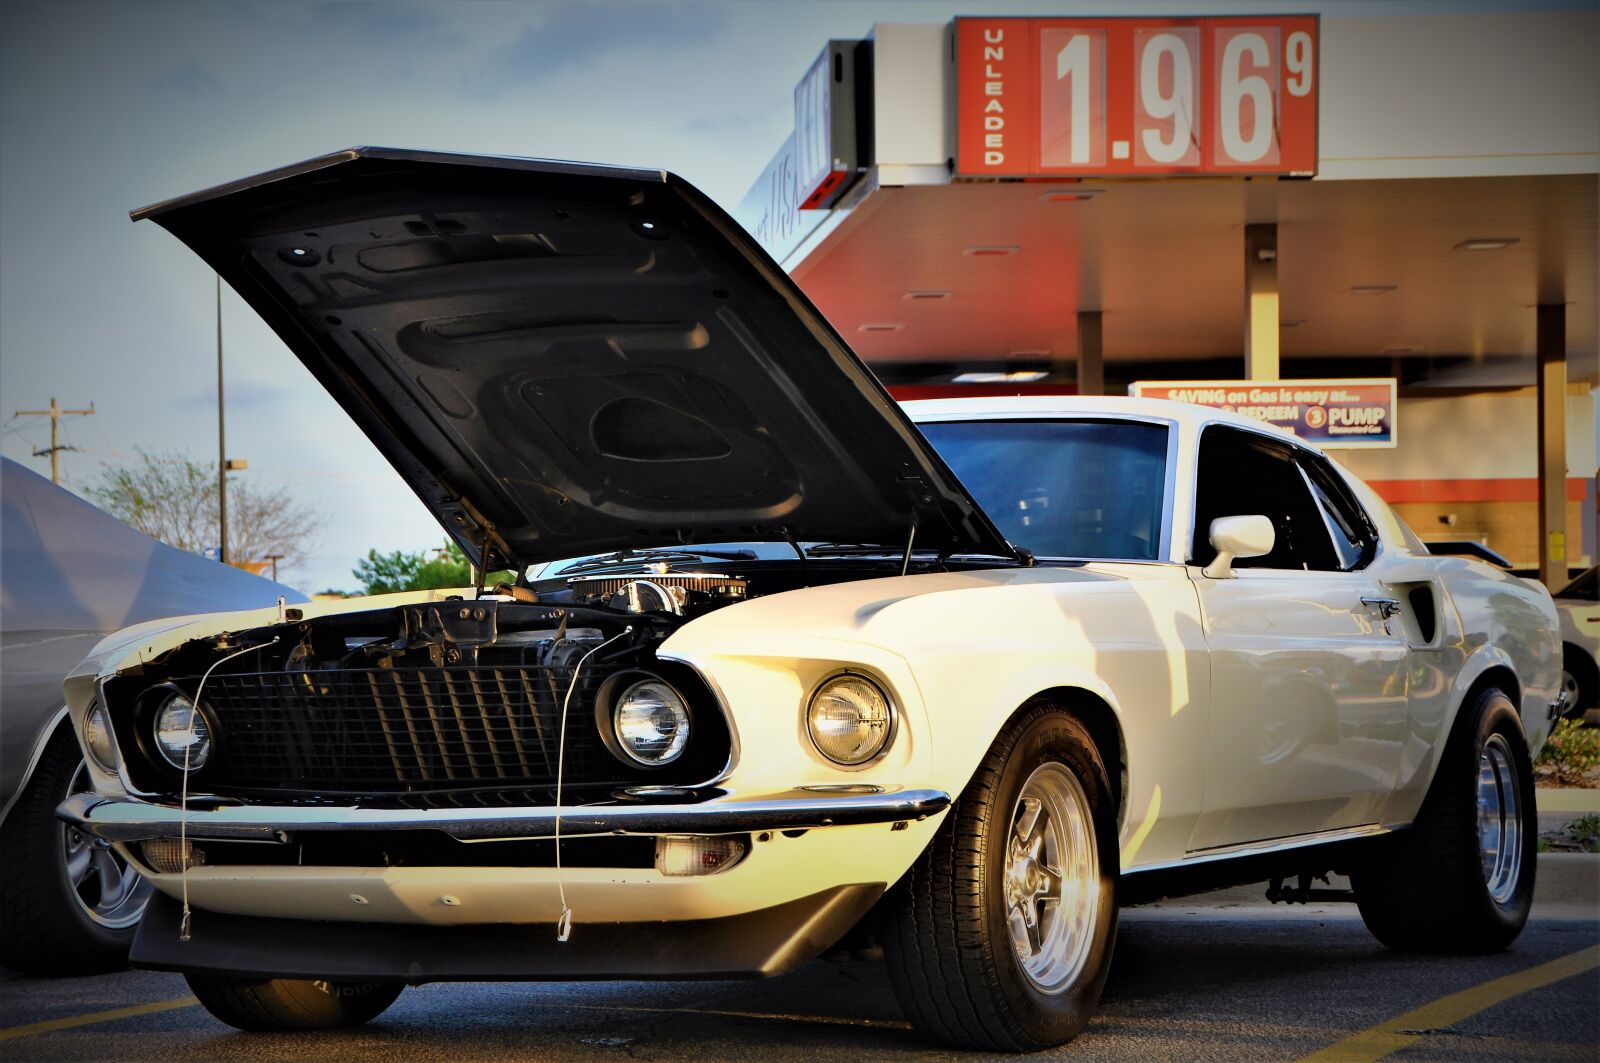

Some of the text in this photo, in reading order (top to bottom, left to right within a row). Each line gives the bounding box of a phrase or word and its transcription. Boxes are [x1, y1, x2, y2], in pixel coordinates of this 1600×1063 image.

[984, 29, 1005, 166] UNLEADED
[1056, 31, 1313, 164] 1.96 9
[1168, 389, 1225, 404] SAVING
[1227, 392, 1248, 404] on
[1249, 389, 1278, 403] Gas
[1280, 388, 1293, 402] is
[1294, 391, 1329, 406] easy
[1237, 406, 1299, 420] REDEEM
[1311, 408, 1386, 426] 3 PUMP
